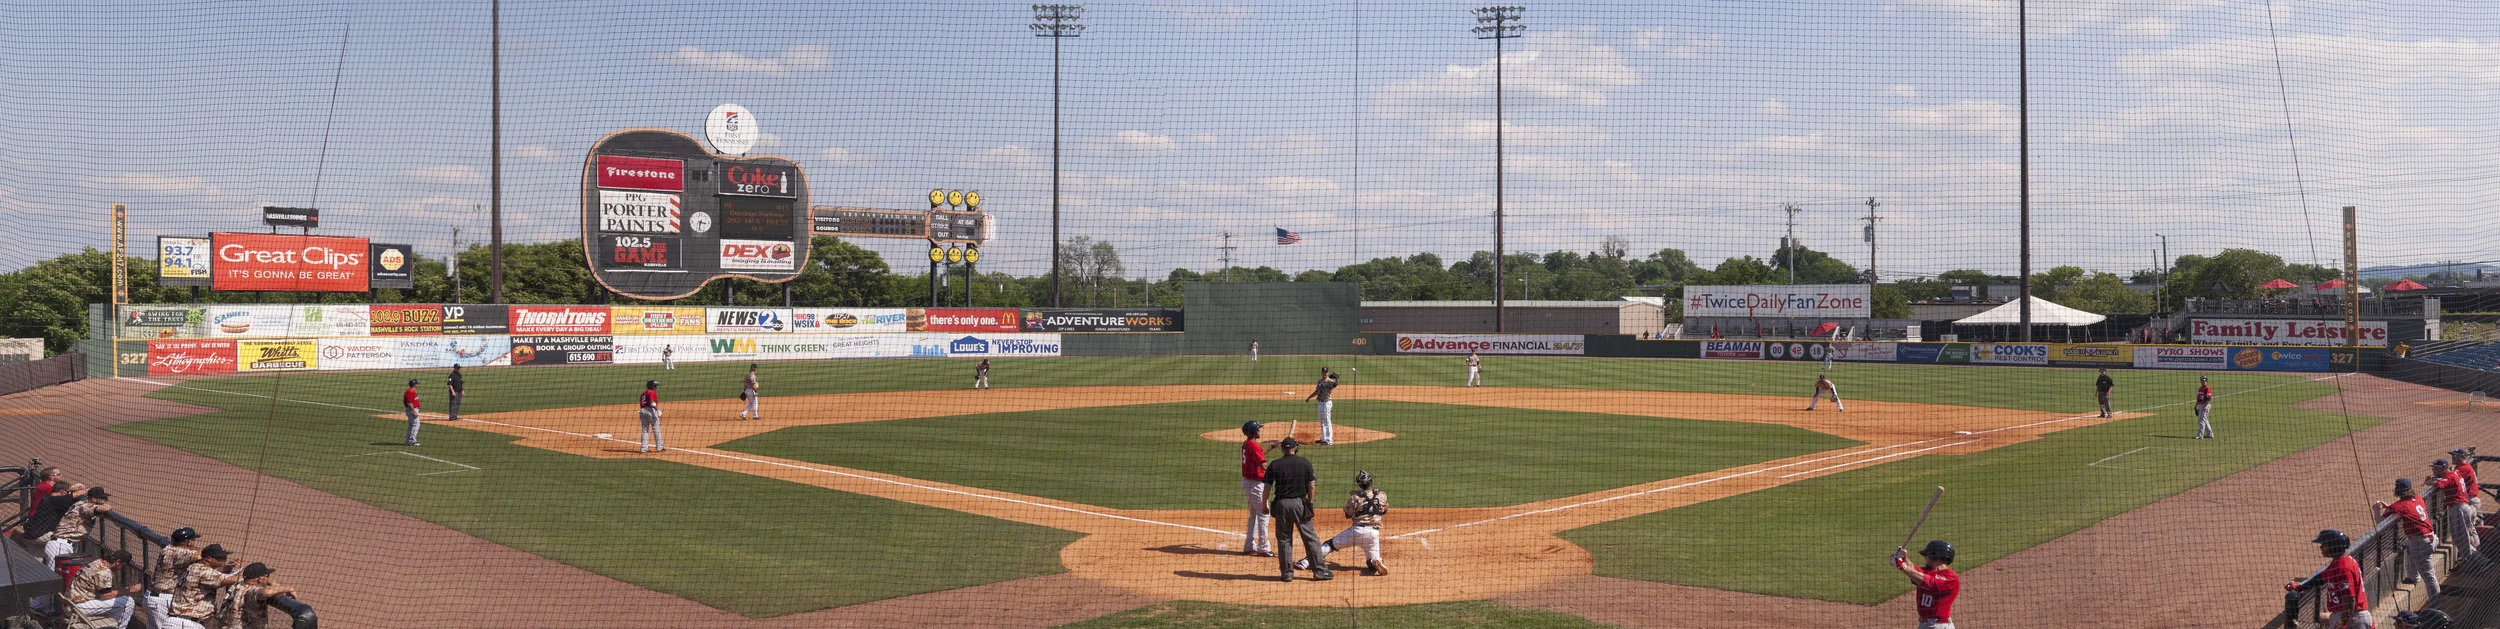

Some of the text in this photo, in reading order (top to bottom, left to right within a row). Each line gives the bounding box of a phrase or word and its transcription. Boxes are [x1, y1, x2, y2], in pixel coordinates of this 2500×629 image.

[606, 166, 676, 180] Firestone
[727, 166, 779, 187] Coke
[737, 183, 770, 193] zero
[625, 193, 646, 202] PPG
[603, 203, 668, 218] PORTER
[607, 219, 666, 233] PAINTS
[615, 236, 651, 248] 102.5
[116, 220, 124, 287] www.AF247.com
[164, 246, 194, 256] 93.7
[220, 244, 297, 264] Great
[614, 247, 667, 264] GAME
[722, 244, 771, 258] DEX
[164, 258, 192, 268] 94.1
[382, 256, 402, 264] ADS
[229, 270, 250, 278] IT'S
[254, 271, 295, 279] GONNA
[1690, 293, 1863, 314] #TwiceDailyFanZone
[214, 311, 250, 324] SABRETT
[371, 309, 400, 323] 102.9
[402, 309, 440, 323] BUZZ
[443, 306, 465, 319] yp
[516, 308, 607, 326] THORNTONS
[876, 313, 906, 323] RIVER
[717, 310, 776, 328] NEWS 2
[795, 320, 815, 328] WSIX
[930, 315, 998, 328] there's only one.
[2192, 321, 2279, 340] Family
[762, 345, 790, 353] THINK
[853, 339, 880, 347] HEIGHTS
[954, 342, 985, 352] LOWE'S
[998, 345, 1059, 353] IMPROVING
[1412, 338, 1583, 350] Advance FINANCIAL 24/7
[1706, 342, 1762, 351] BEAMAN
[1772, 346, 1782, 354] 00
[1813, 347, 1821, 355] 18
[1994, 345, 2046, 356] COOK'S
[120, 353, 148, 365] 327
[569, 352, 611, 361] 615 690 HITS
[2330, 353, 2354, 363] 327
[2415, 504, 2427, 521] 9
[1921, 593, 1933, 608] 10
